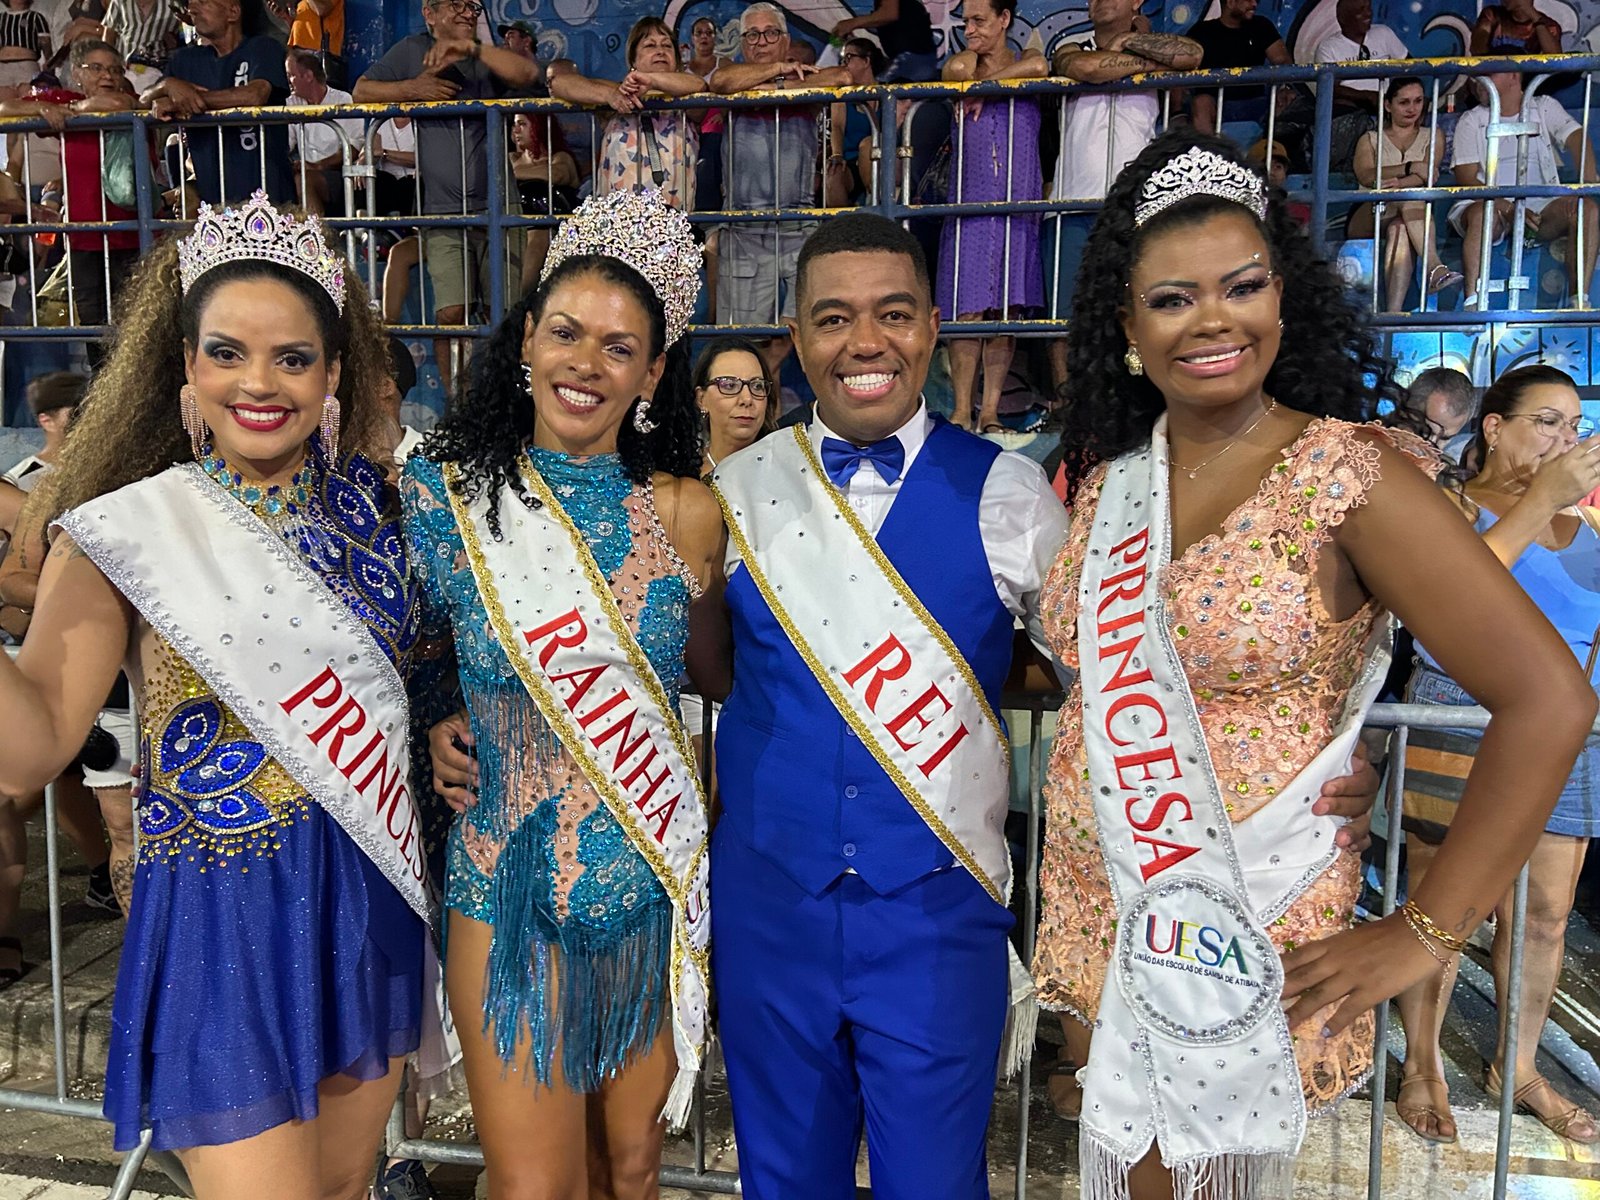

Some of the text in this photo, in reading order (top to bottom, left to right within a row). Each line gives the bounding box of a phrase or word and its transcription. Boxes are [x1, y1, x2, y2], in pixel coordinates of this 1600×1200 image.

[278, 664, 437, 904] PRINCES
[522, 605, 682, 845] RAINHA
[840, 630, 970, 781] REI
[1096, 526, 1202, 885] PRINCESA
[1145, 913, 1249, 975] UESA
[1151, 957, 1165, 967] DAS
[1165, 959, 1194, 973] ESCOLAS
[1194, 966, 1203, 975] DE
[1203, 968, 1223, 980] SAMBA
[1224, 975, 1234, 984] DE
[1234, 978, 1260, 988] ATIBAIA
